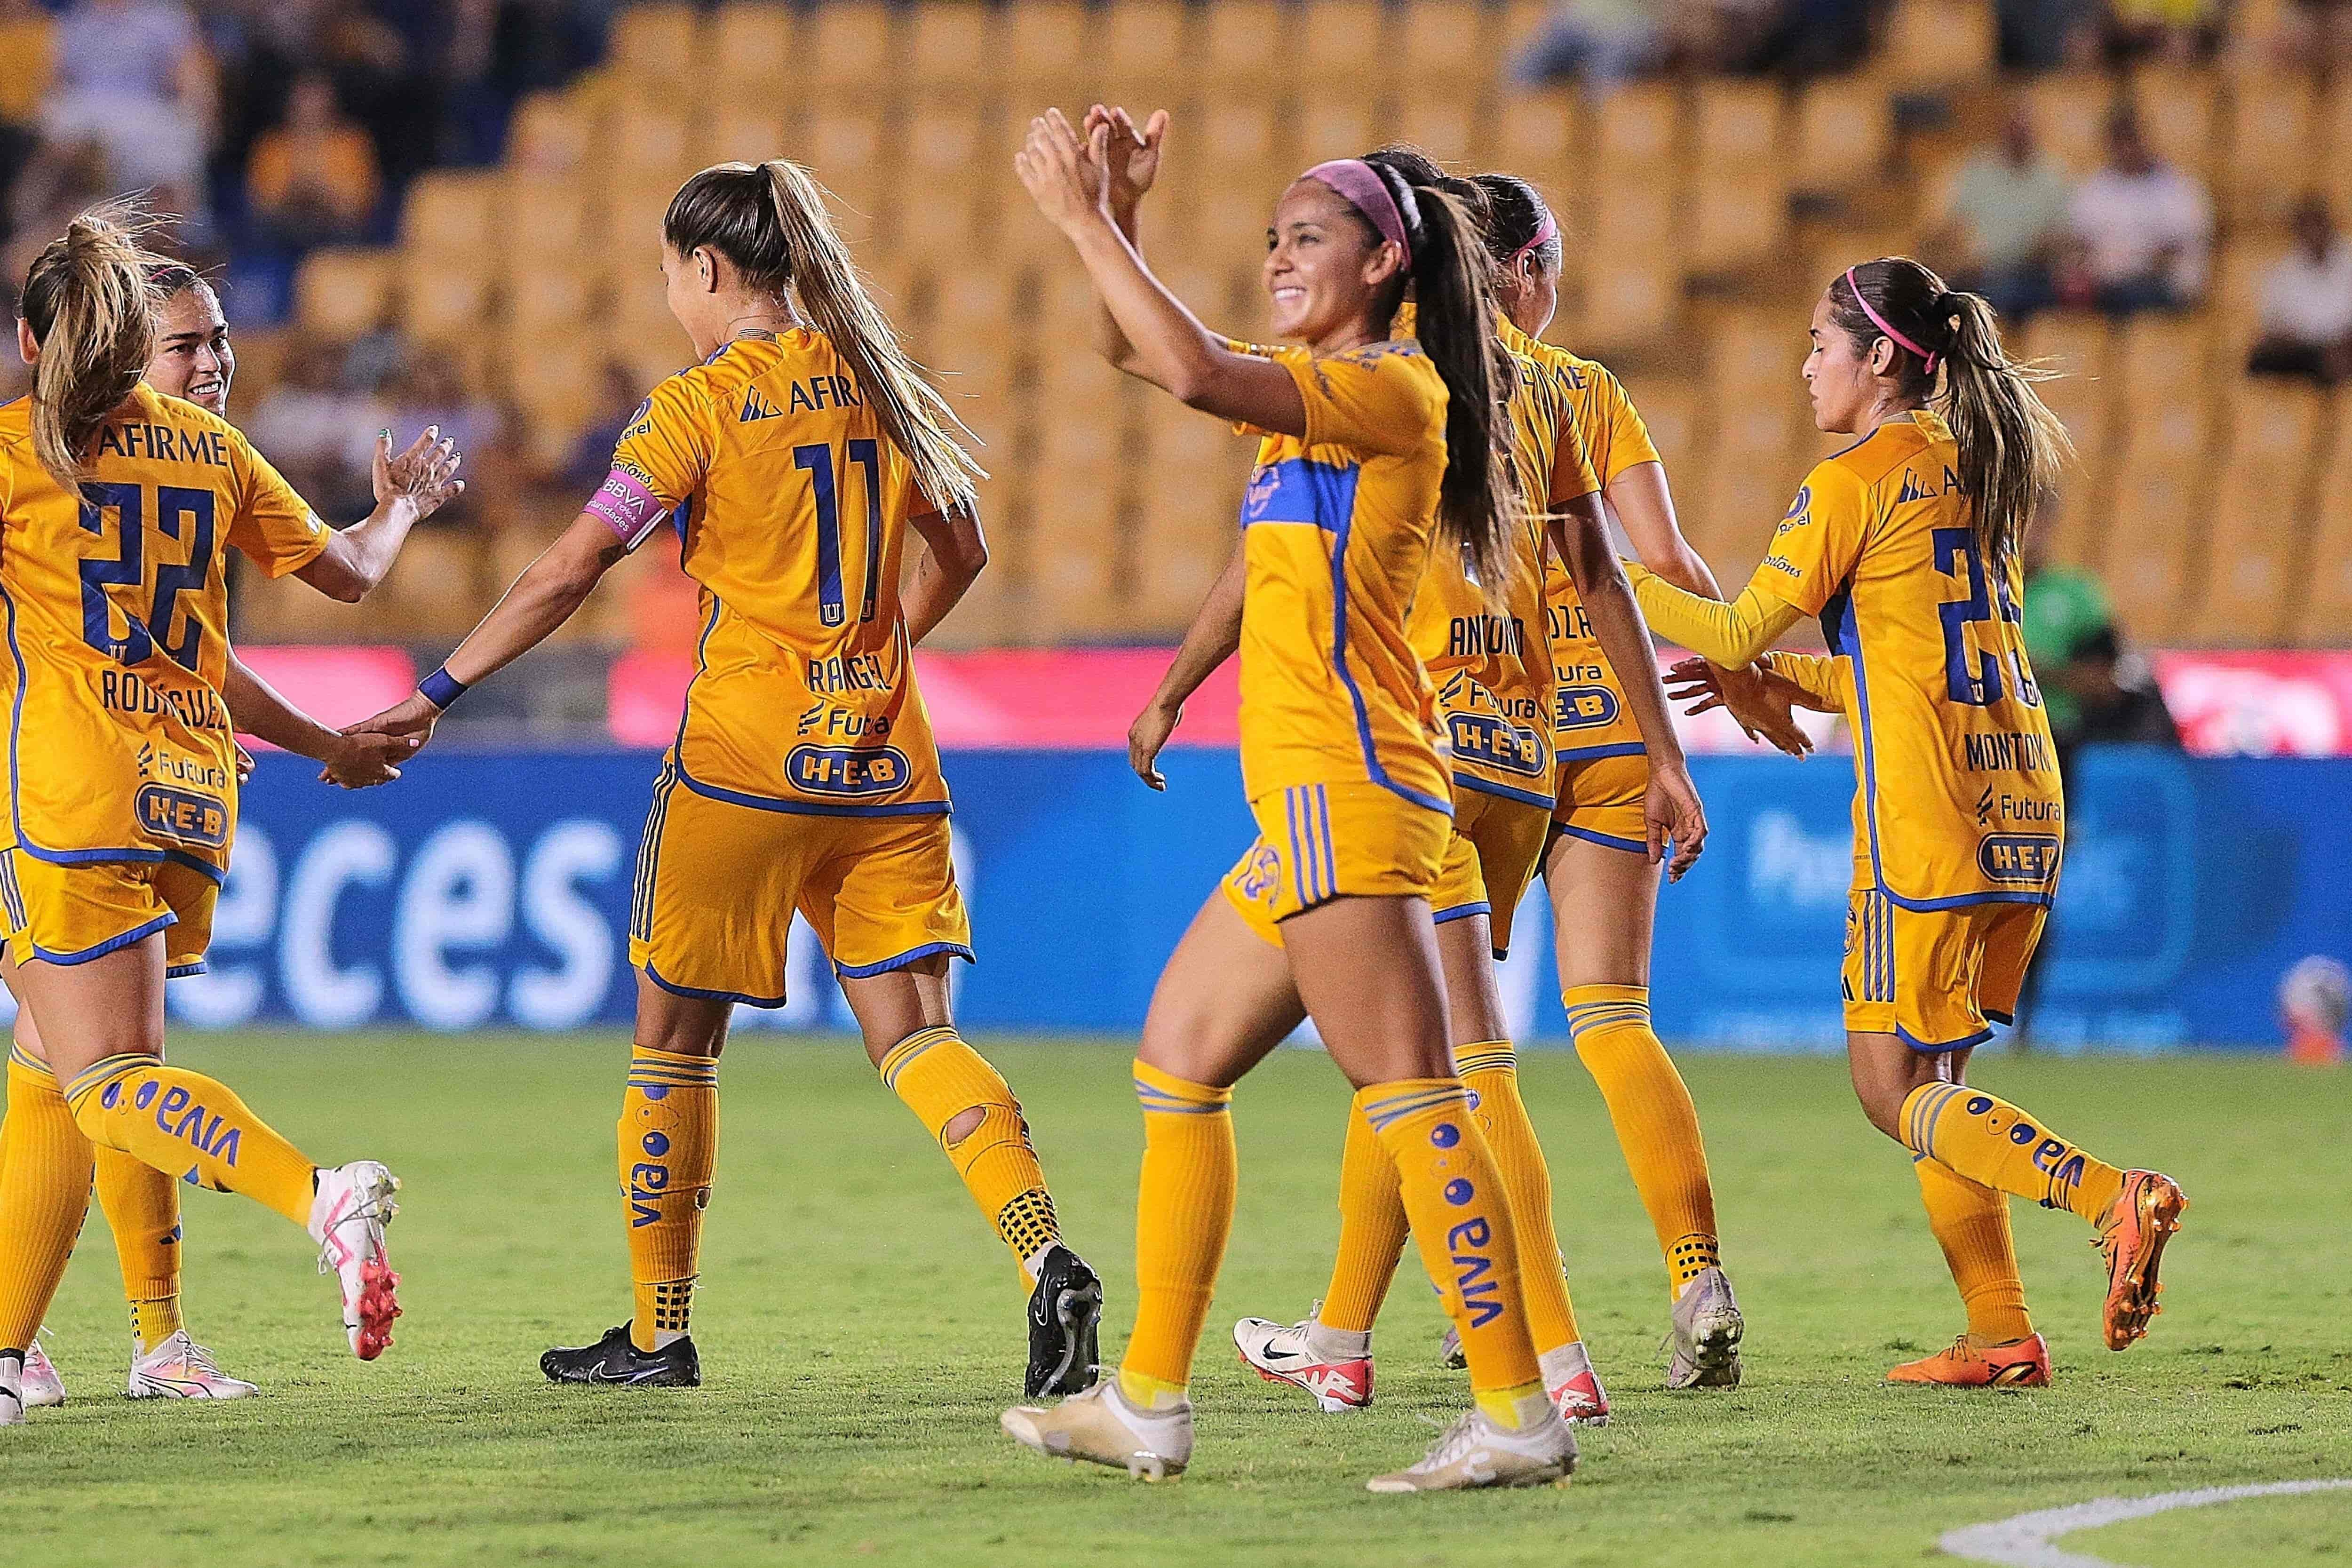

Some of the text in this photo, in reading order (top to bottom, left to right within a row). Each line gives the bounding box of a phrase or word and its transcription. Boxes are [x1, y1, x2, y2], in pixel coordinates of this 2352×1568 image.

[789, 374, 865, 415] AFIR
[98, 423, 229, 467] AFIRME
[602, 479, 645, 516] BBVA
[793, 438, 878, 628] 11
[78, 481, 215, 672] 22
[159, 752, 226, 789] Futura
[2001, 794, 2061, 822] Futura
[1448, 1217, 1504, 1329] viva
